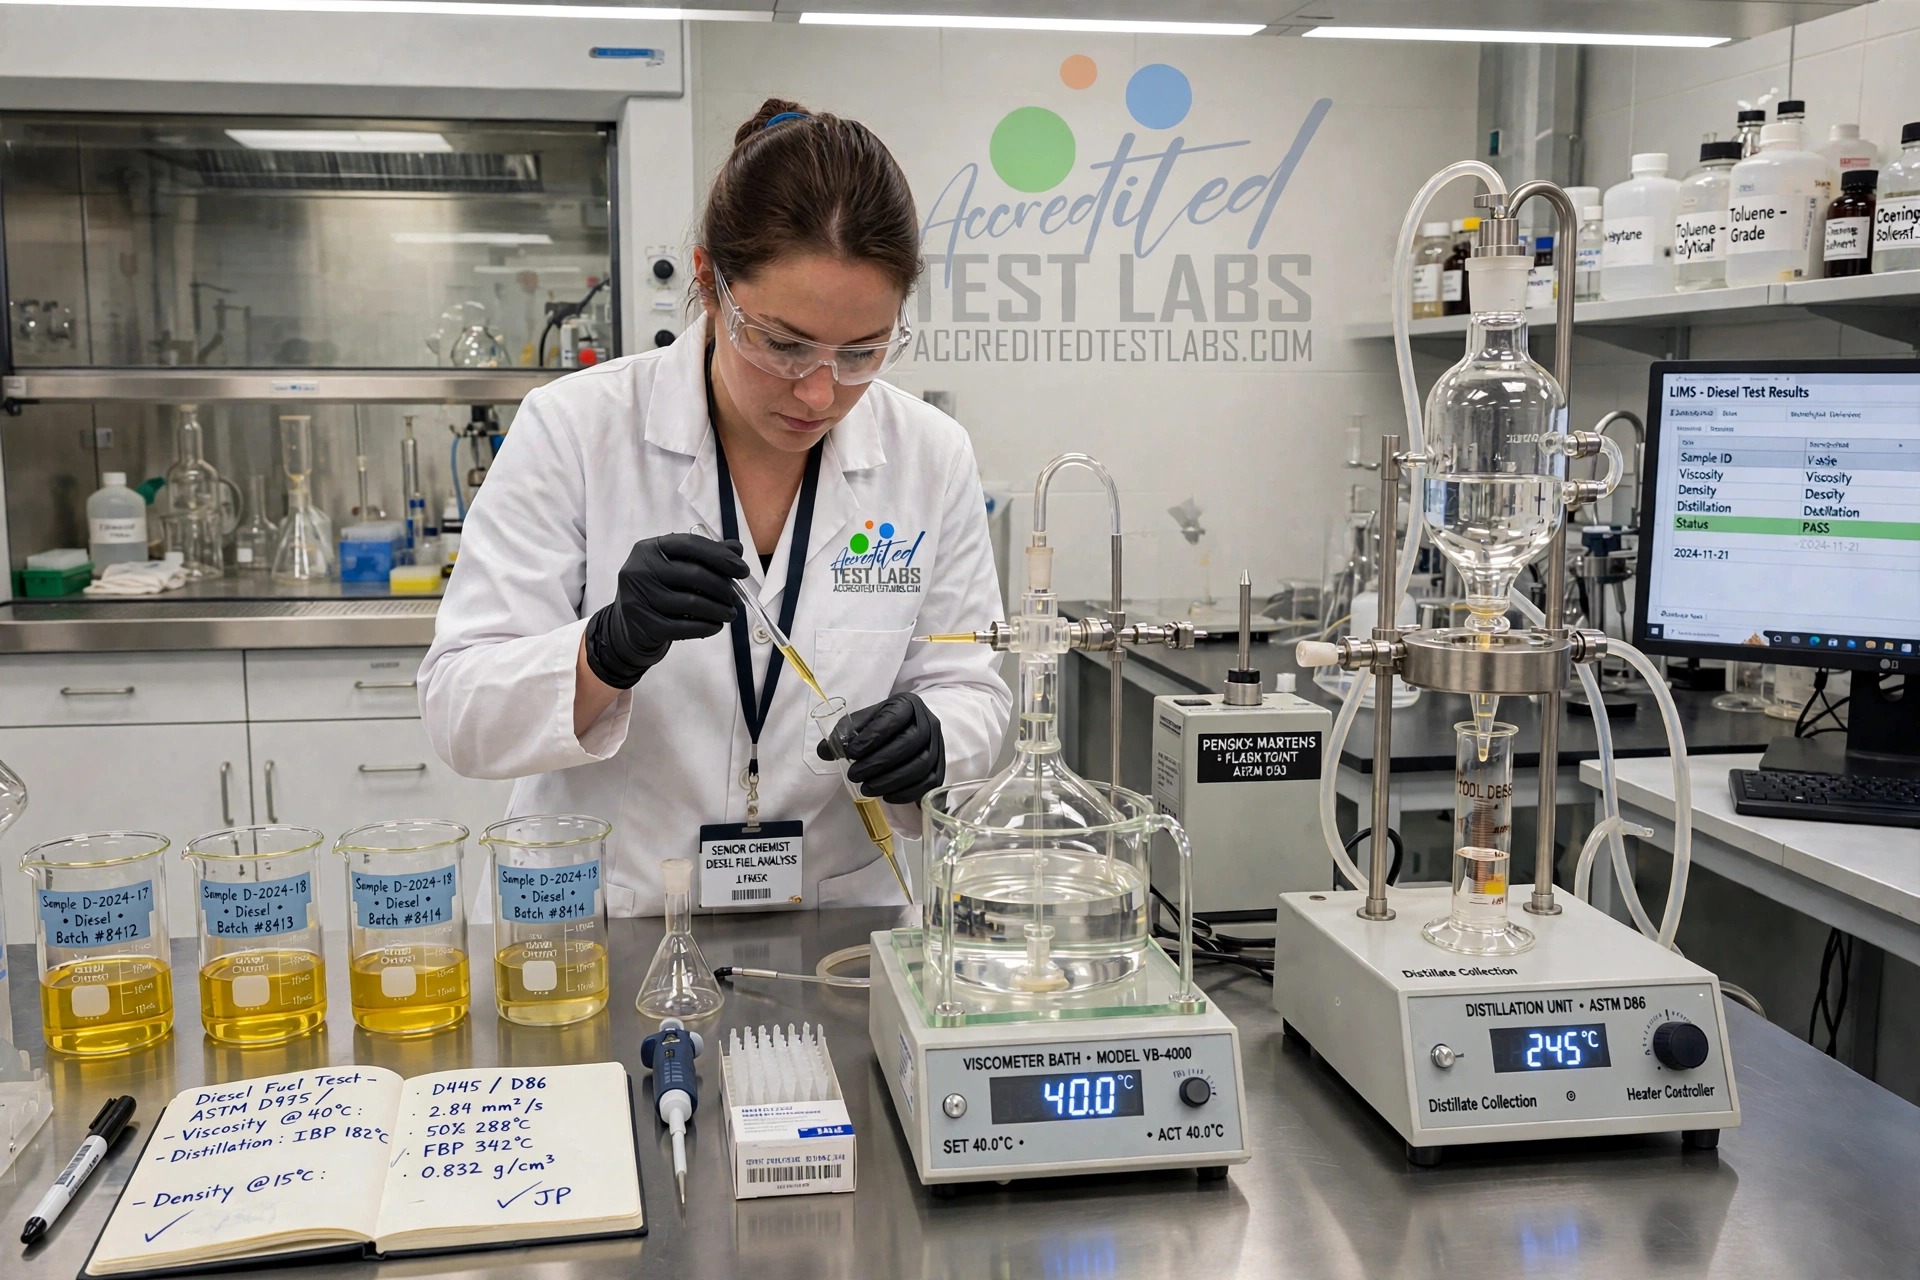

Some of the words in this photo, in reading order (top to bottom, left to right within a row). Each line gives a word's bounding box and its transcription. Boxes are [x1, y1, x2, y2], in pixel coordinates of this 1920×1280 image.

[918, 97, 1333, 289] Accredited
[1729, 205, 1775, 223] Toluene
[1676, 221, 1716, 238] Toluene
[1730, 225, 1765, 243] Grade
[917, 253, 1090, 323] TEST
[1119, 253, 1312, 323] LABS
[913, 328, 1312, 362] ACCREDITEDTESTLABS.COM
[1669, 386, 1697, 398] LIMS
[1707, 385, 1740, 398] Diesel
[1742, 386, 1766, 398] Test
[1769, 386, 1810, 398] Results
[1680, 452, 1717, 466] Sample
[1720, 453, 1733, 464] ID
[1679, 468, 1724, 482] Viscosity
[1806, 471, 1852, 486] Viscosity
[1678, 484, 1717, 499] Density
[1677, 501, 1732, 513] Distillation
[1675, 517, 1709, 530] Status
[1802, 522, 1830, 534] PASS
[830, 530, 926, 575] Accredited
[1674, 548, 1729, 560] 2024-11-21
[831, 567, 873, 584] TEST
[878, 567, 921, 584] LABS
[1257, 736, 1316, 749] MARTENS
[711, 844, 746, 855] SENIOR
[749, 841, 790, 853] CHEMIST
[83, 887, 149, 910] D-2024-17
[243, 879, 307, 901] D-2024-18
[532, 888, 565, 903] Diesel
[235, 902, 270, 918] Diesel
[386, 894, 419, 909] Diesel
[514, 906, 544, 919] Batch
[548, 902, 585, 919] #8414
[75, 911, 111, 927] Diesel
[217, 920, 249, 934] Batch
[254, 916, 294, 933] #8413
[368, 912, 398, 926] Batch
[404, 907, 443, 924] #8414
[94, 924, 139, 943] #8412
[1402, 968, 1457, 979] Distillate
[1458, 966, 1518, 978] Collection
[1465, 1000, 1545, 1018] DISTILLATION
[1547, 999, 1573, 1014] UNIT
[1589, 997, 1621, 1012] ASTM
[1623, 996, 1646, 1010] D86
[963, 1053, 1045, 1071] VISCOMETER
[1049, 1052, 1082, 1067] BATH
[1096, 1048, 1141, 1064] MODEL
[1142, 1046, 1192, 1062] VB-4000
[195, 1085, 253, 1106] Diesel
[432, 1080, 482, 1096] D445
[511, 1077, 547, 1090] D86
[188, 1102, 248, 1122] ASTM
[429, 1102, 472, 1118] 2.84
[1428, 1098, 1478, 1113] Distillate
[1481, 1094, 1537, 1110] Collection
[182, 1118, 267, 1141] Viscosity
[475, 1117, 531, 1134] 288°C
[1157, 1127, 1182, 1142] ACT
[1185, 1124, 1225, 1140] 40.0°C
[291, 1126, 337, 1143] IBP
[345, 1126, 389, 1145] 182°C
[943, 1139, 969, 1154] SET
[973, 1135, 1013, 1152] 40.0°C
[423, 1141, 464, 1158] FBP
[475, 1136, 533, 1153] 342°C
[421, 1162, 483, 1178] 0.832
[153, 1184, 235, 1209] Density
[534, 1187, 572, 1206] JP
